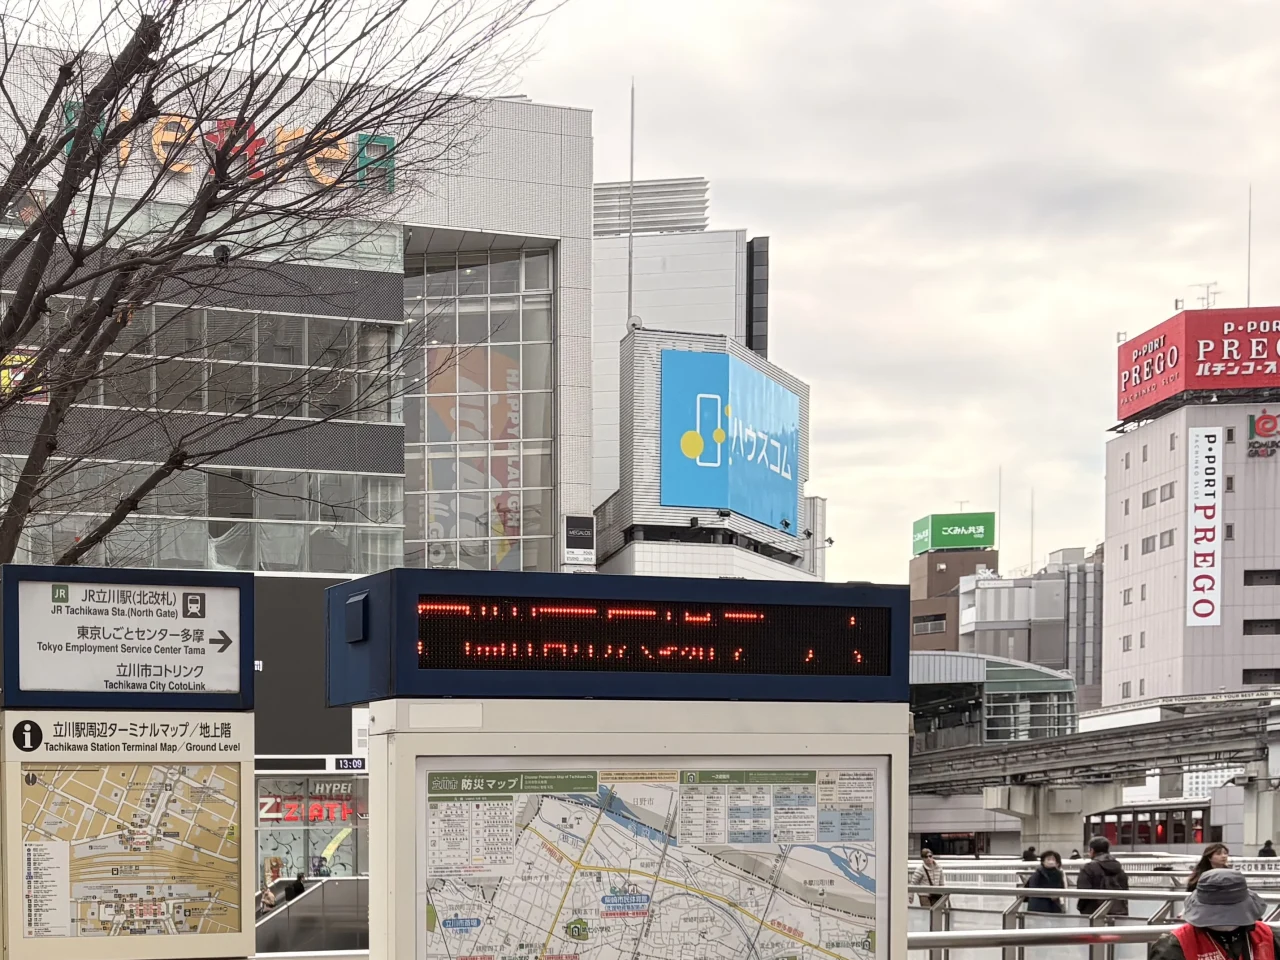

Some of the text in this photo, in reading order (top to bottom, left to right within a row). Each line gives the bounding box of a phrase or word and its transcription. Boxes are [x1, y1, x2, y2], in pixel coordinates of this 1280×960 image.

[1121, 345, 1178, 392] PREGO
[731, 416, 793, 481] ハウスコム
[942, 525, 984, 535] こくみん共済
[1192, 503, 1217, 619] PREGO
[54, 588, 66, 599] JR
[81, 588, 177, 606] JR立川駅(北改札)
[51, 606, 178, 619] JR Tachikawa Sta.(North Gate)
[77, 626, 204, 643] 東京しごとセンター多摩
[37, 642, 205, 655] Tokyo Employment Service Center Tama
[116, 663, 204, 677] 立川市コトリンク
[104, 680, 206, 692] Tachikawa City CotoLink
[53, 721, 232, 738] 立川駅周辺ターミナルマップ／地上階
[340, 760, 362, 768] 13:09
[431, 778, 518, 791] 立川市 防災マップ
[632, 797, 654, 806] 日野市
